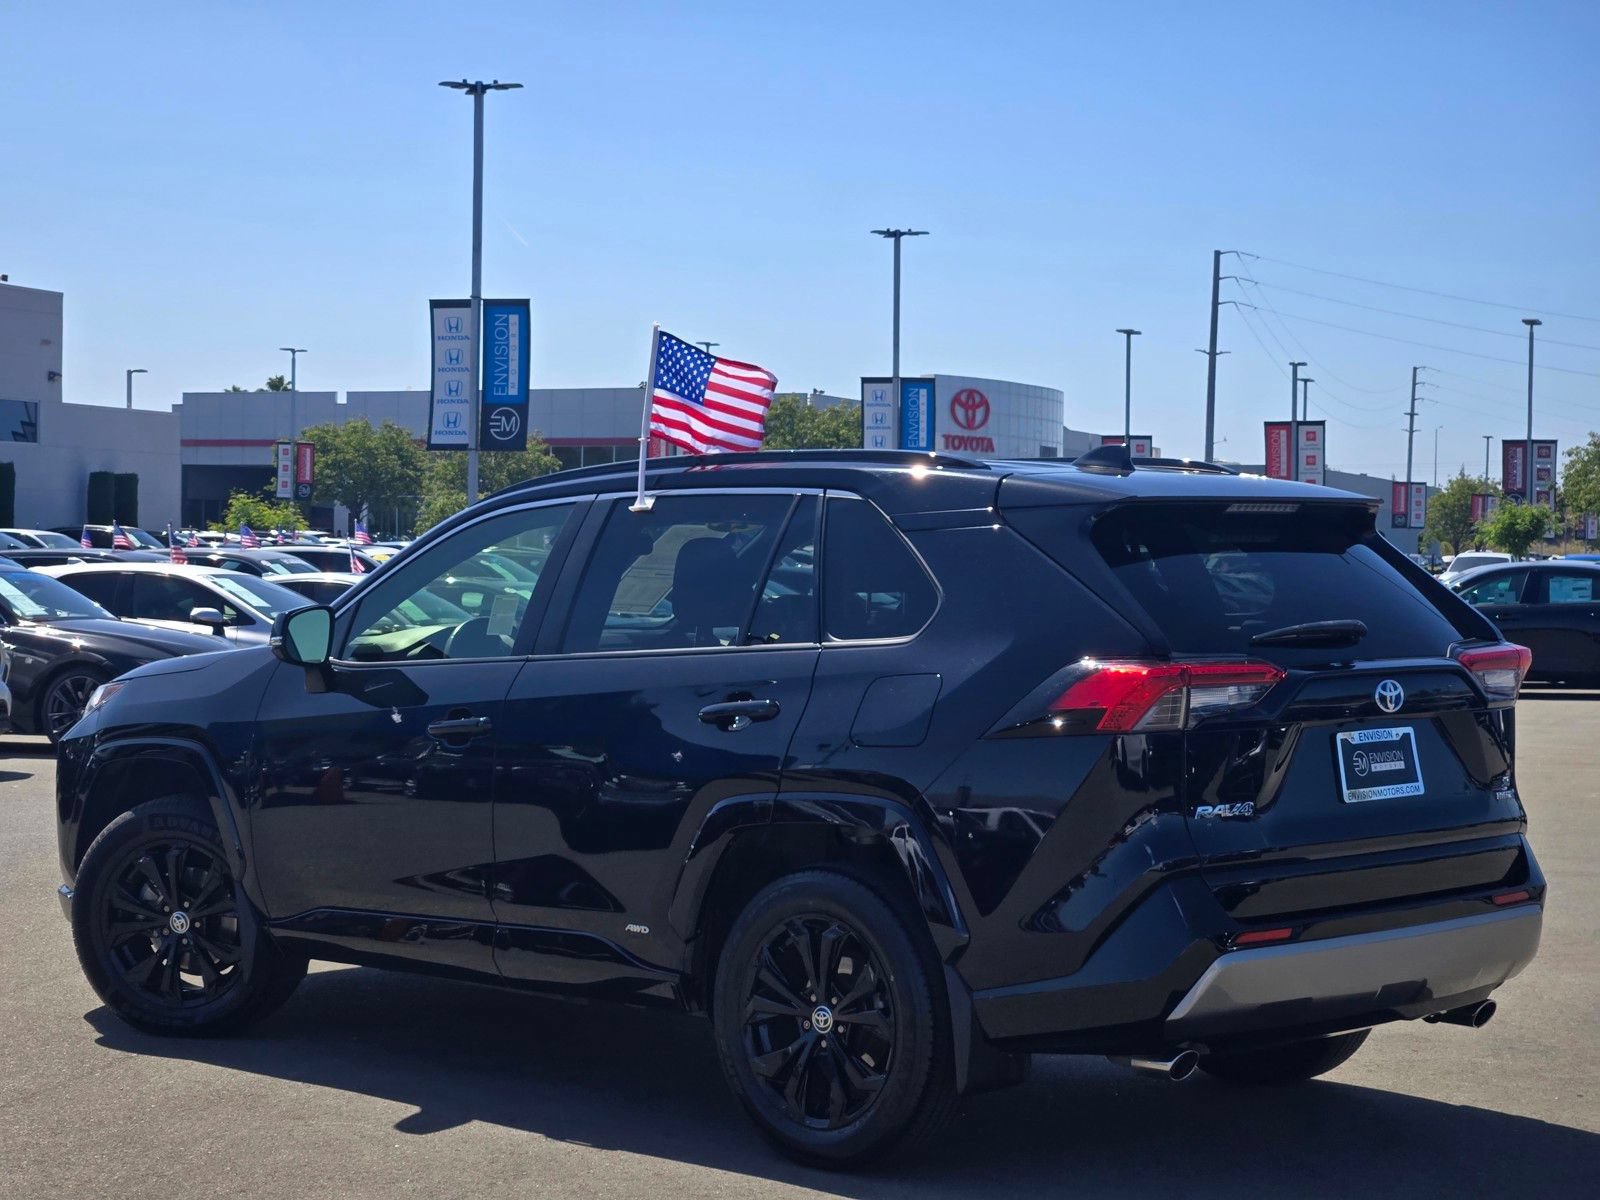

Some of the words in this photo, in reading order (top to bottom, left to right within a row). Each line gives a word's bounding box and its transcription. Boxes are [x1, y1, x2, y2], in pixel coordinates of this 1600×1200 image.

[494, 313, 508, 396] ENVISION
[908, 387, 919, 448] ENVISION
[942, 434, 995, 453] TOYOTA
[1358, 730, 1393, 742] ENVISION
[1369, 750, 1404, 764] ENVISION
[1347, 785, 1420, 801] ENVISIONMOTORS.COM
[1194, 801, 1254, 819] RAV4
[625, 923, 650, 934] AWD
